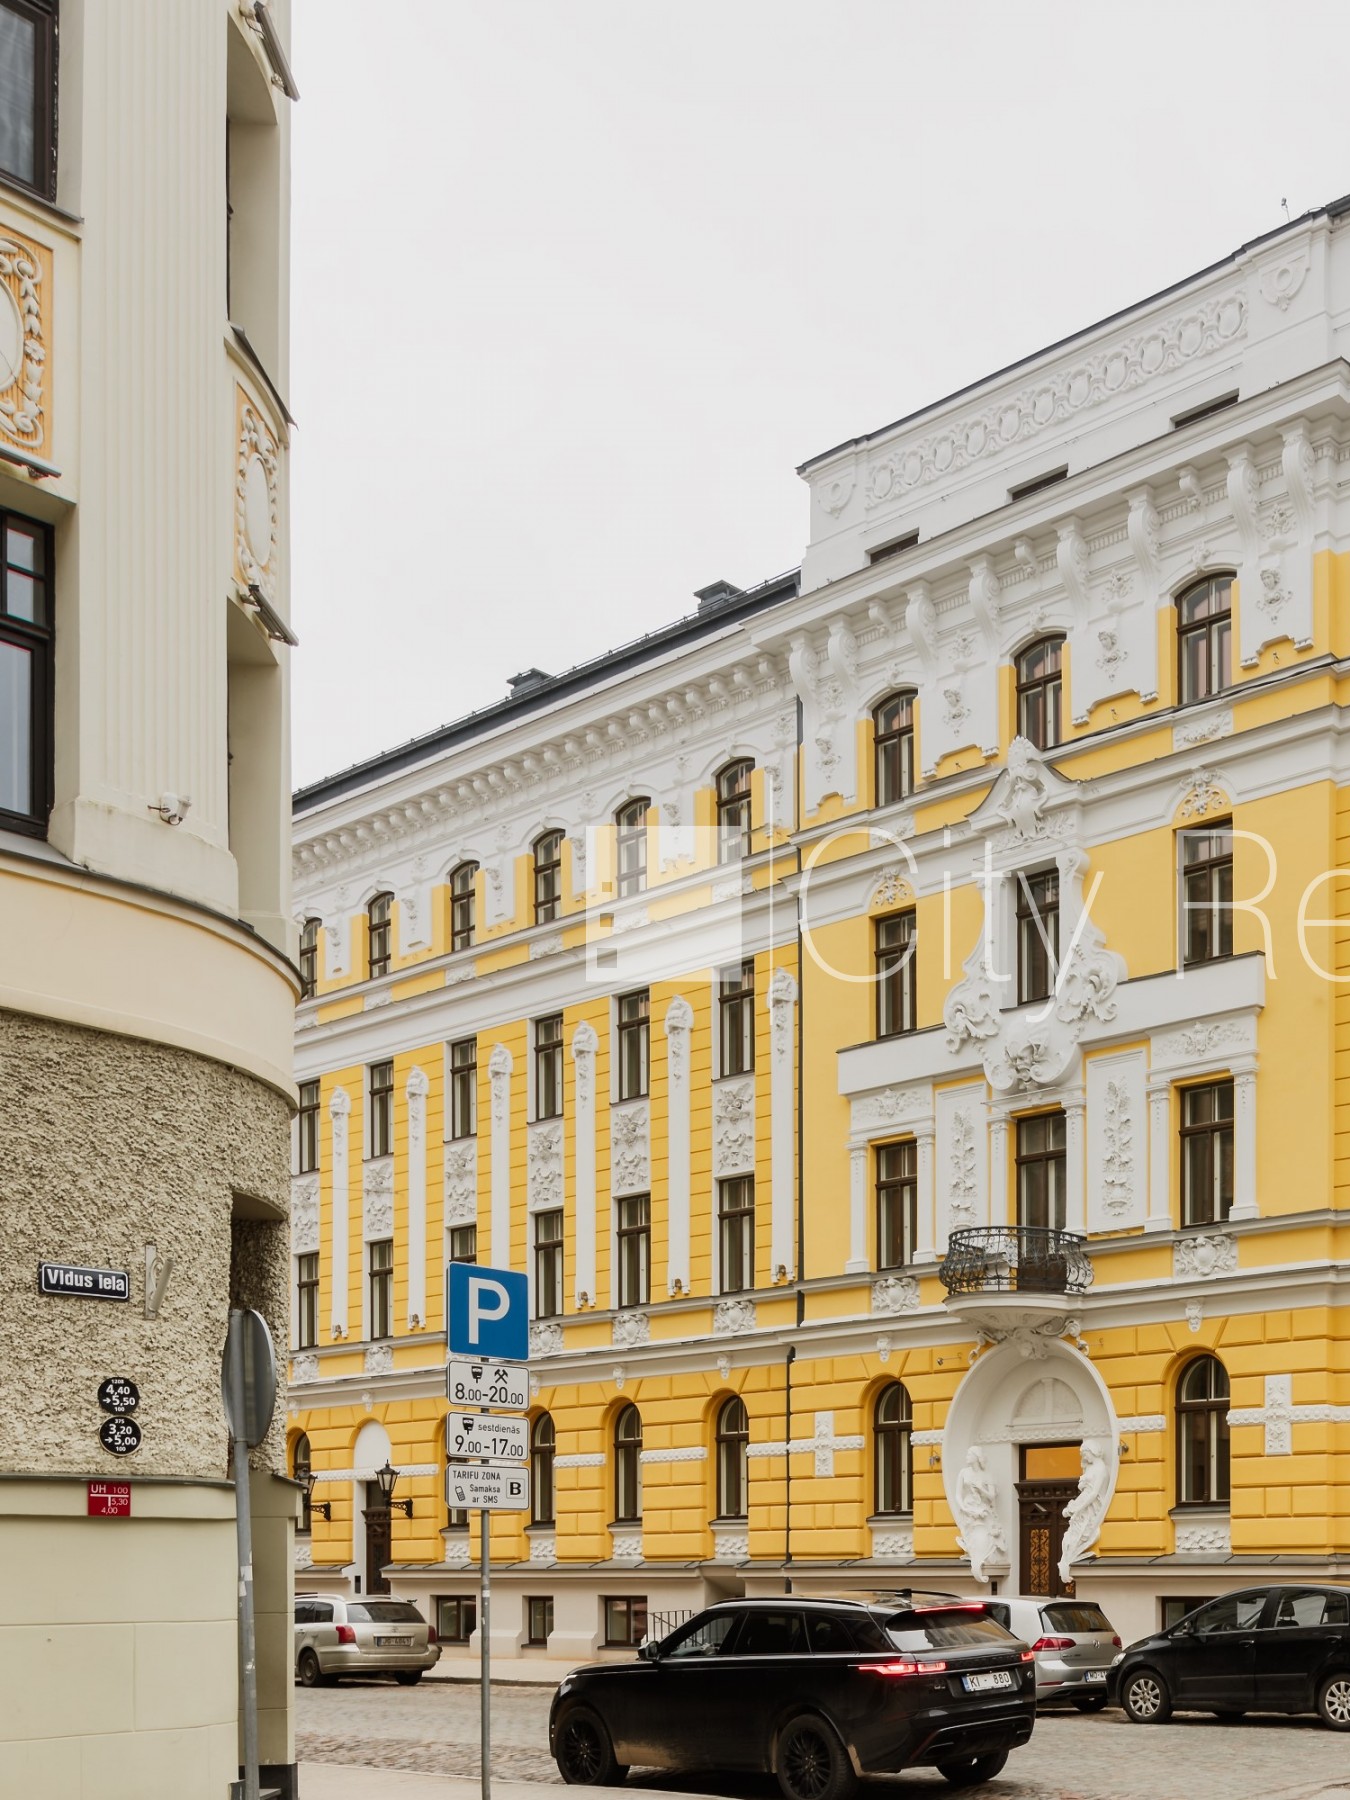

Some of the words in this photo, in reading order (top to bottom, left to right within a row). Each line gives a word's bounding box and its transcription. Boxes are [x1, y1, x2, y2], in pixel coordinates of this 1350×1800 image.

[46, 1268, 94, 1288] Vidus
[98, 1274, 125, 1292] iela
[468, 1276, 510, 1344] P
[106, 1384, 130, 1395] 4,40
[455, 1382, 524, 1405] 8.00-20.00
[112, 1395, 136, 1406] 5,50
[108, 1424, 132, 1436] 3,20
[477, 1423, 521, 1435] sestdienās
[114, 1435, 137, 1446] 5,00
[452, 1470, 479, 1480] TARIFU
[481, 1471, 501, 1481] ZONA
[91, 1484, 106, 1494] UH
[113, 1486, 129, 1494] 100
[469, 1483, 501, 1493] Samaksa
[509, 1481, 522, 1496] B
[483, 1495, 498, 1503] SMS
